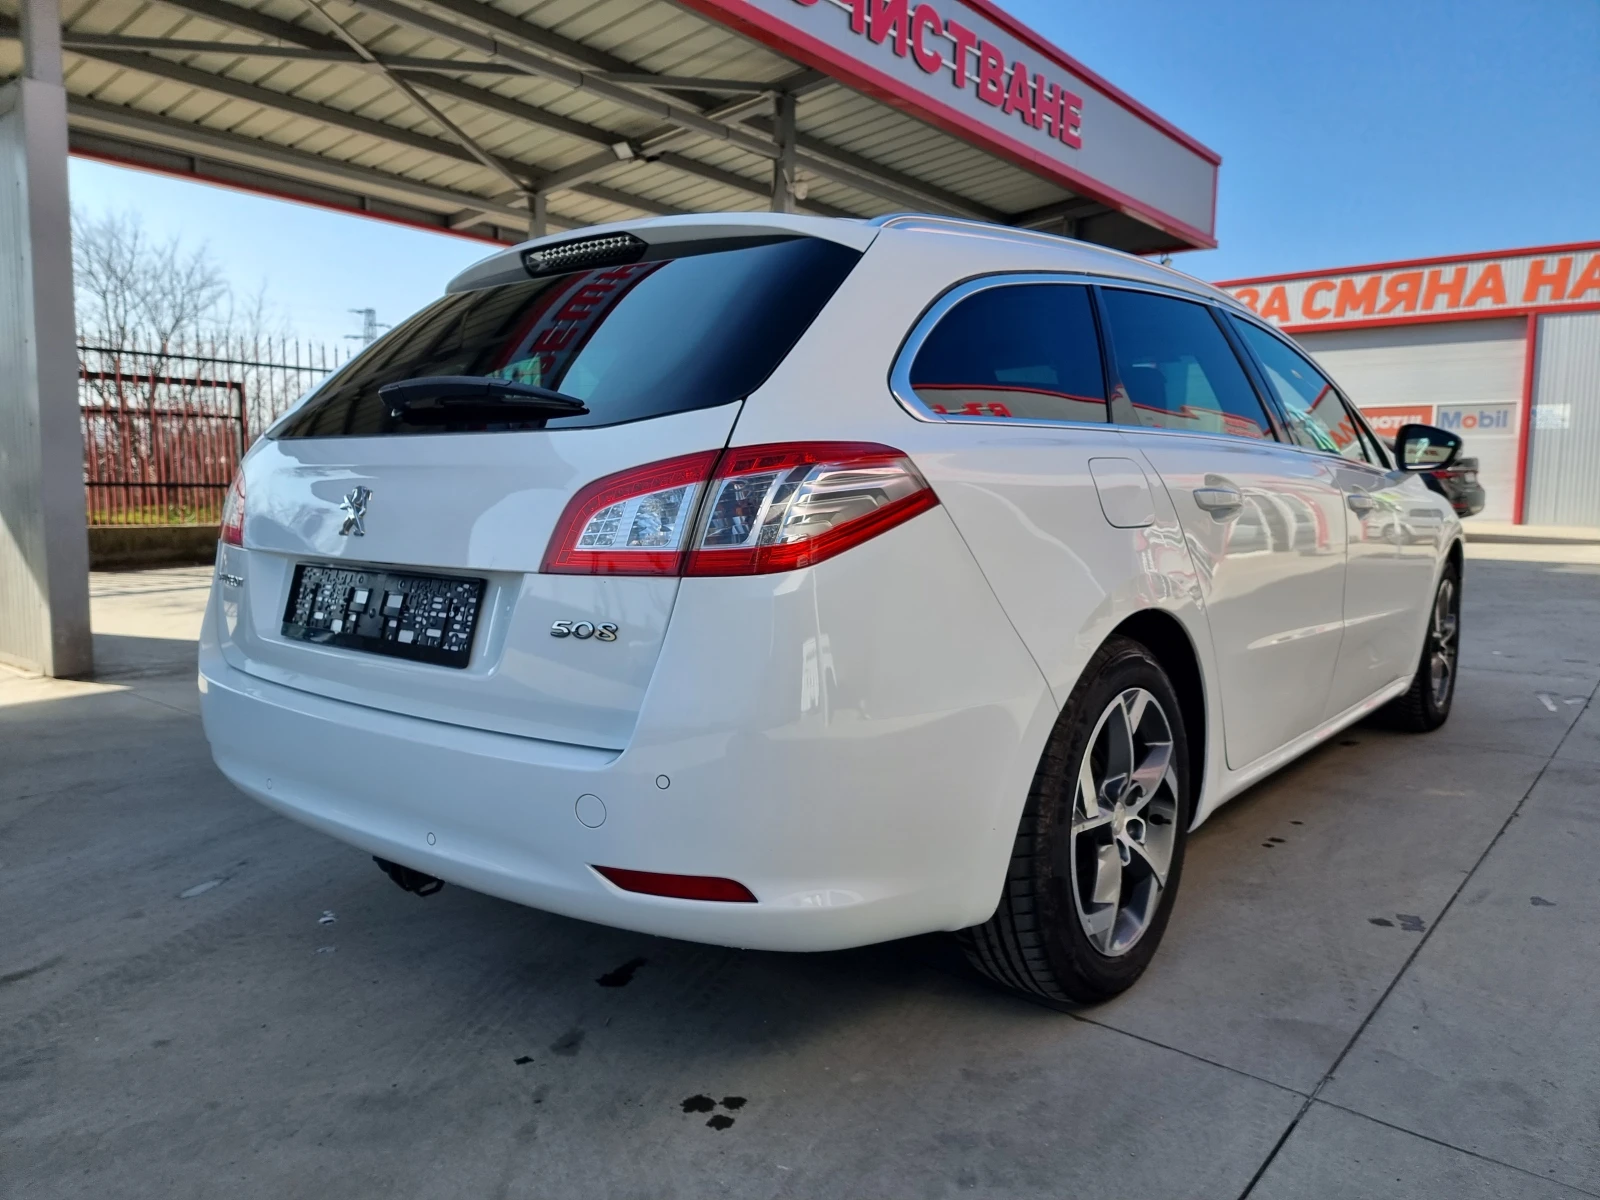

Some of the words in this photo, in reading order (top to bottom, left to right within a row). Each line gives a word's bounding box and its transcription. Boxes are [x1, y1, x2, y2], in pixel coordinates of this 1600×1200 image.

[790, 0, 1083, 149] ИСТВАНЕ
[1301, 263, 1508, 320] СМЯНА
[1522, 253, 1600, 303] НА
[1440, 409, 1509, 430] Mobil
[550, 619, 619, 642] 508
